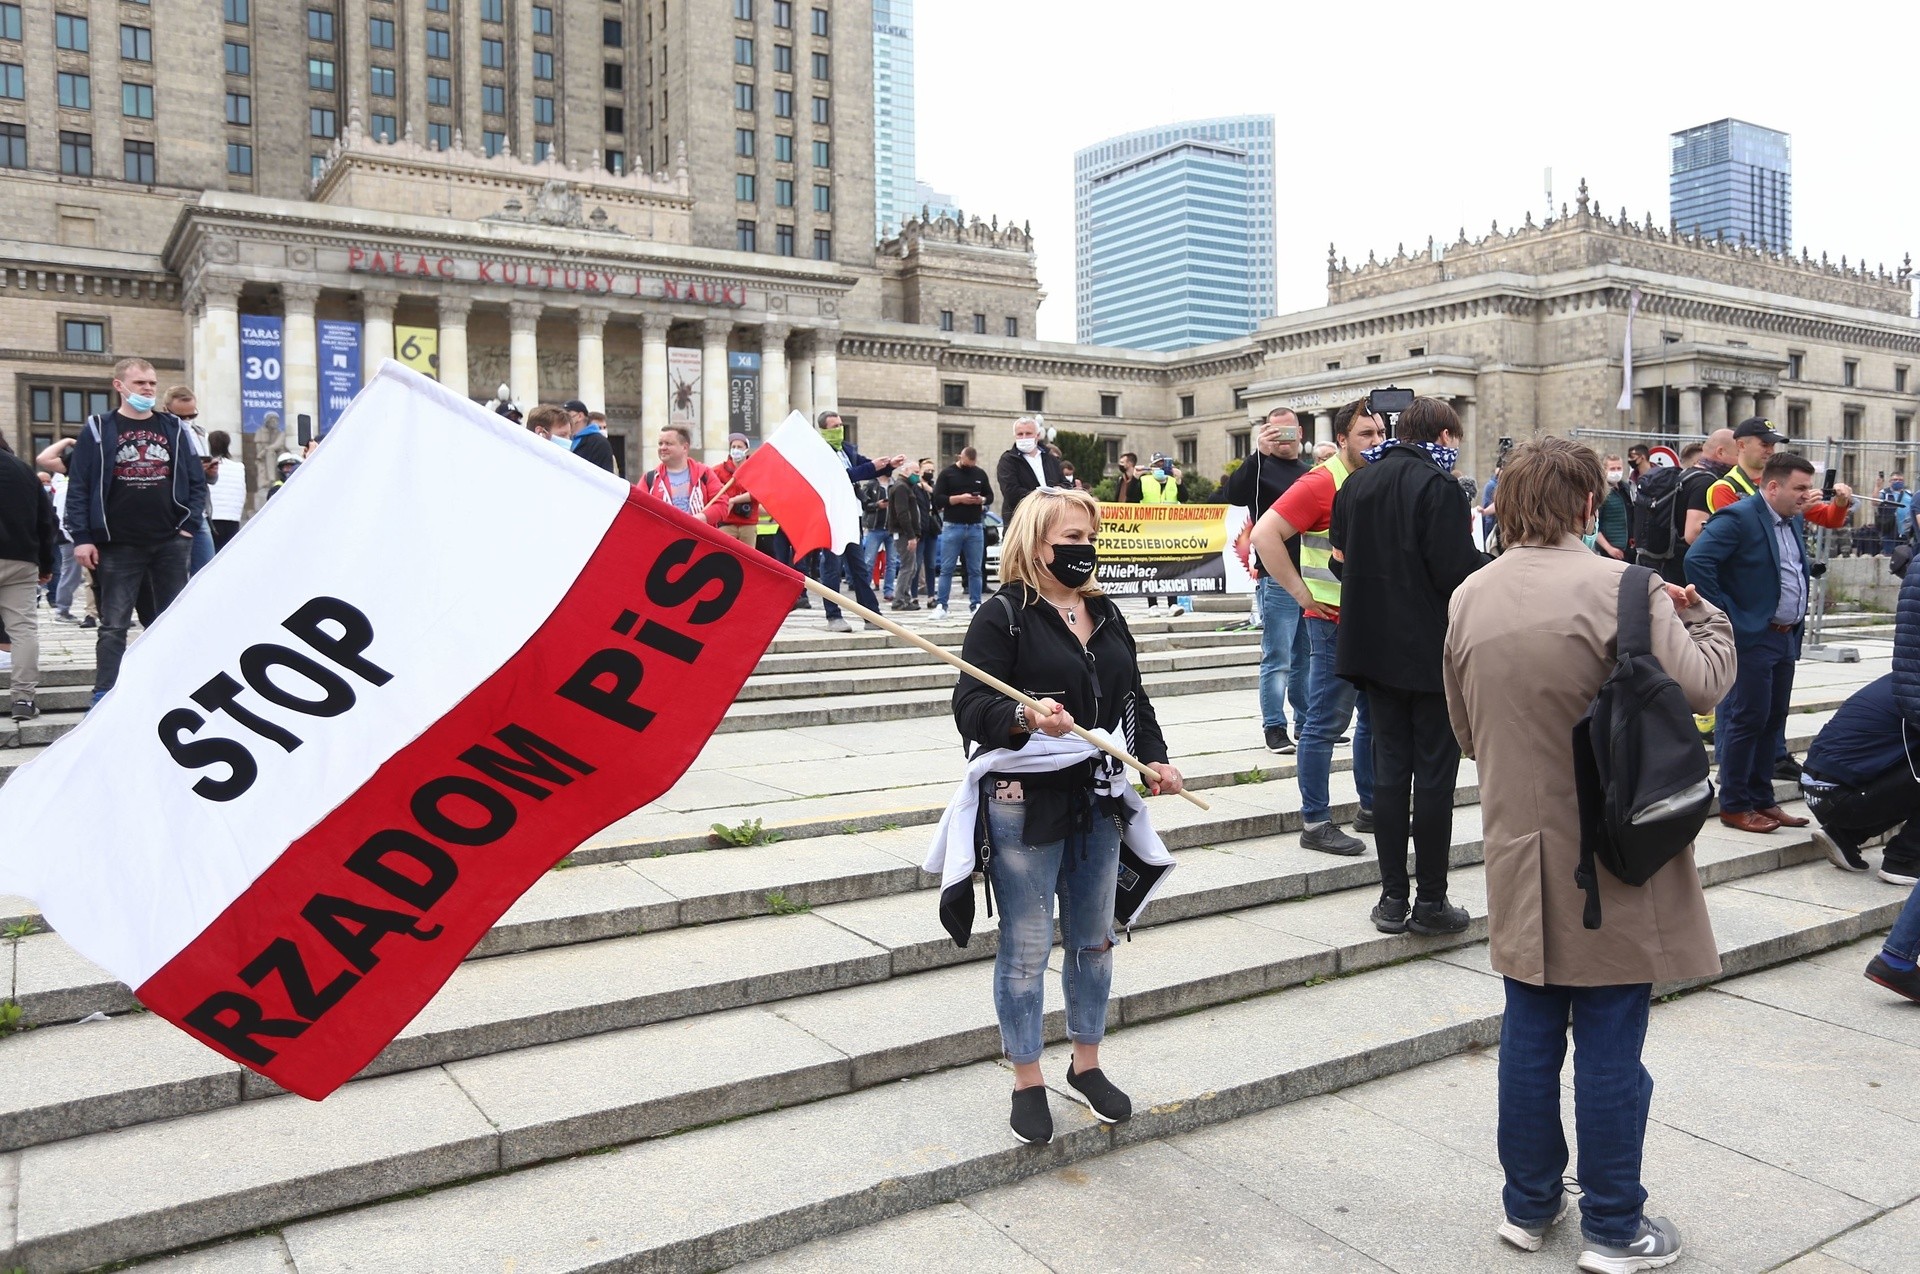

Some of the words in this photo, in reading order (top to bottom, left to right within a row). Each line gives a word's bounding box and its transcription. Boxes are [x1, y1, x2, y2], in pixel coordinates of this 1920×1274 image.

[348, 247, 455, 279] PAŁAC
[479, 259, 617, 293] KULTURY
[635, 275, 642, 296] I
[663, 279, 747, 306] NAUKI
[242, 327, 280, 340] TARAS
[401, 335, 422, 361] 6
[245, 356, 281, 381] 30
[242, 389, 283, 399] VIEWING
[242, 399, 283, 409] TERRACE
[731, 378, 741, 414] Civitas
[741, 379, 754, 431] Collegium
[1134, 507, 1168, 521] KOMITET
[1169, 507, 1226, 521] ORGANIZACYJNY
[1098, 564, 1158, 579] #NiePłacę
[1142, 578, 1189, 593] POLSKICH
[1191, 577, 1216, 592] FIRM
[1218, 577, 1223, 591] !
[158, 596, 393, 801] STOP
[182, 723, 597, 1066] RZĄDOM
[555, 538, 744, 732] PiS
